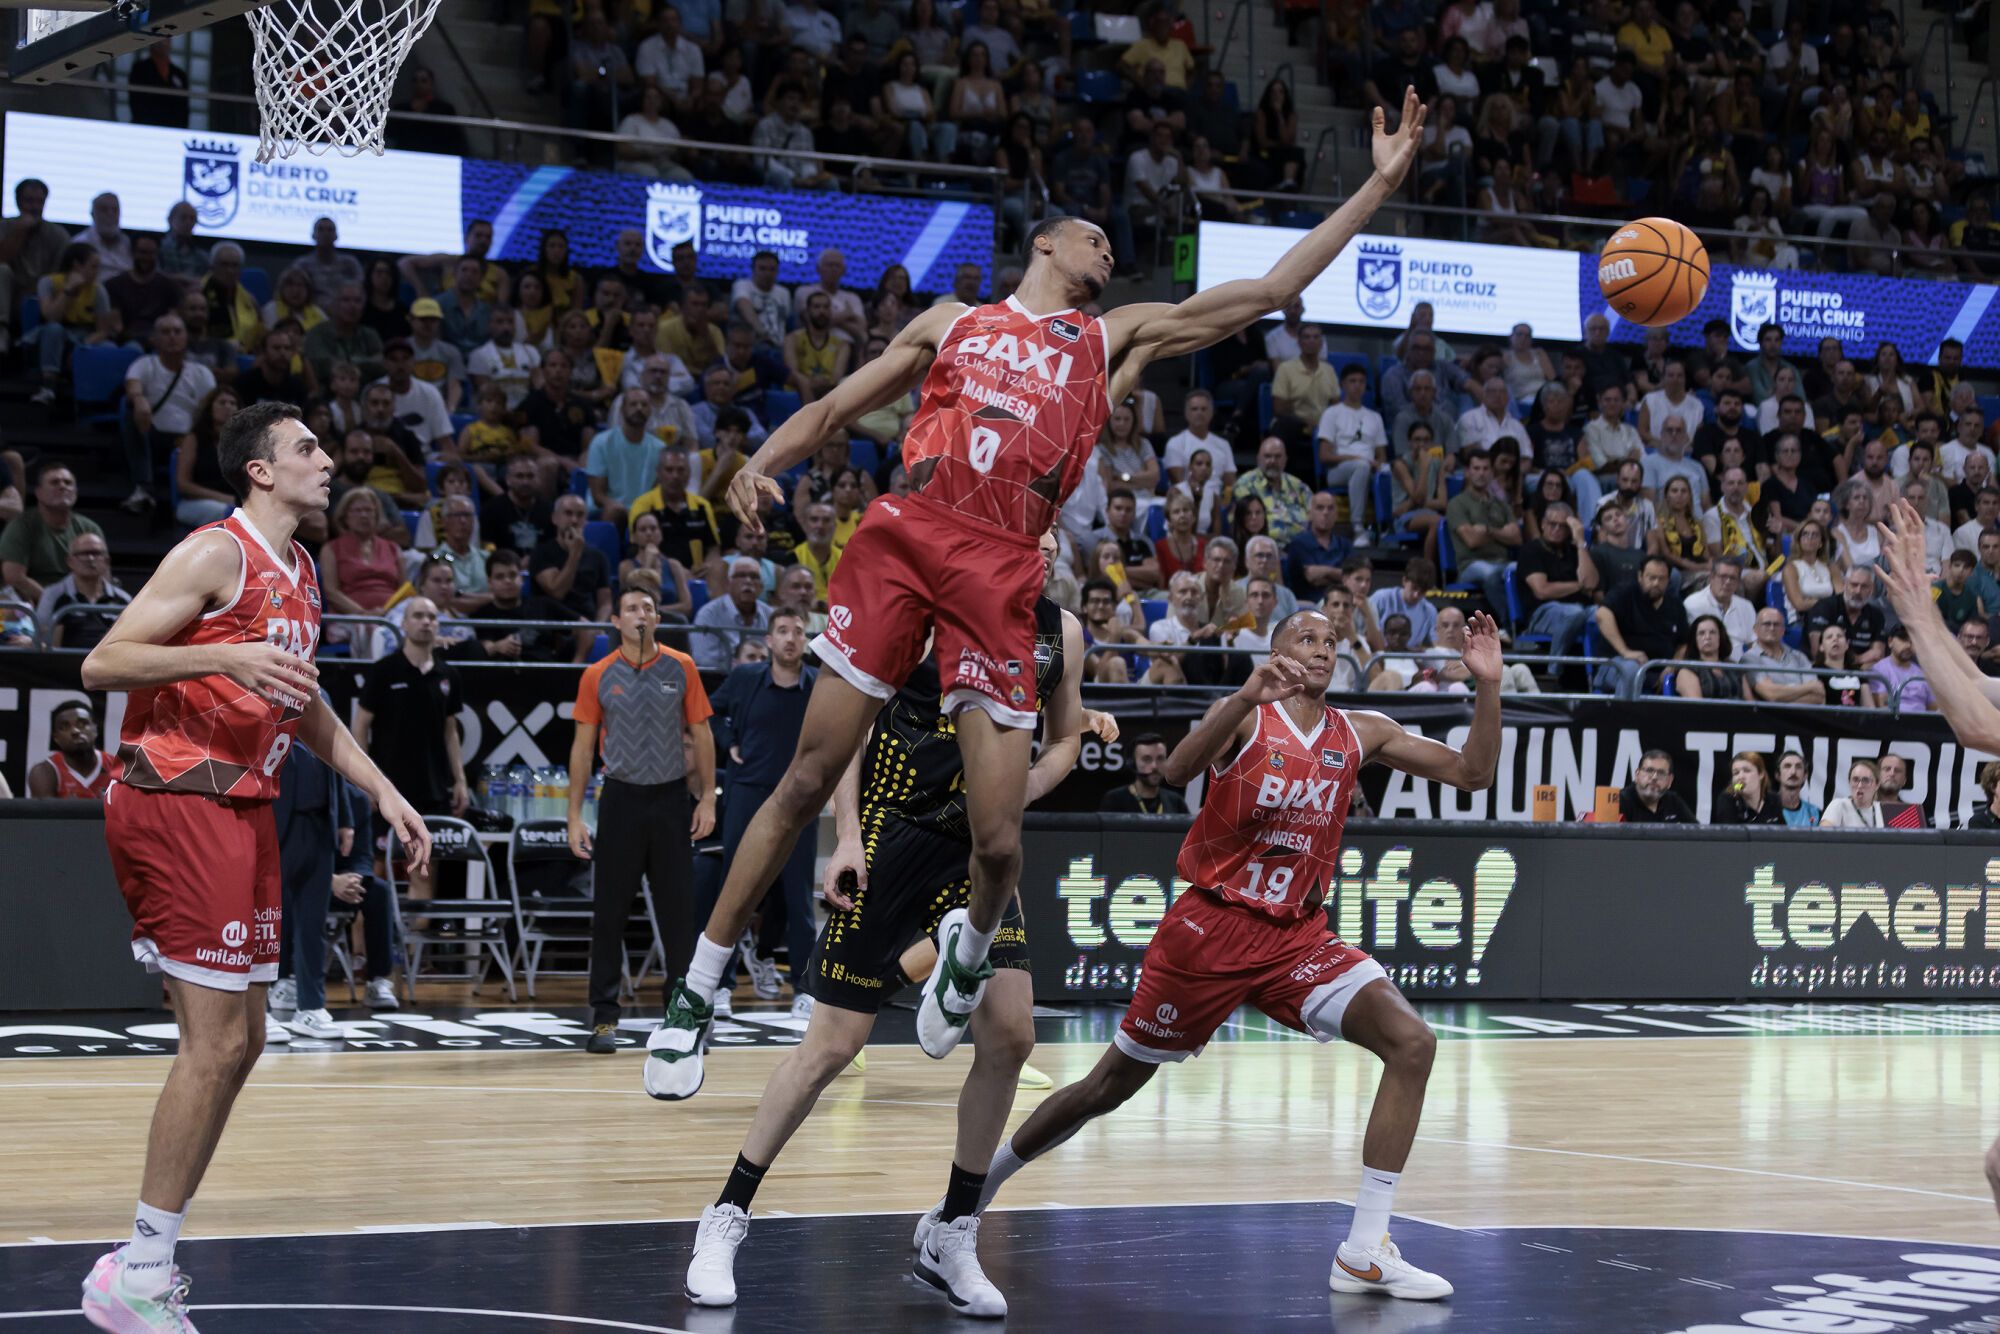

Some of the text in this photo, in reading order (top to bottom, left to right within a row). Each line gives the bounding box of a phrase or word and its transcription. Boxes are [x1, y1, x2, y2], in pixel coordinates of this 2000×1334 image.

[249, 160, 329, 183] PUERTO
[305, 187, 358, 205] CRUZ
[705, 204, 782, 227] PUERTO
[755, 228, 808, 248] CRUZ
[1409, 259, 1473, 277] PUERTO
[1453, 281, 1497, 298] CRUZ
[1781, 289, 1842, 309] PUERTO
[1822, 308, 1865, 328] CRUZ
[957, 332, 1073, 388] BAXI
[954, 355, 1062, 404] CLIMATIZACIÓN
[961, 376, 1037, 426] MANRESA
[968, 426, 1002, 474] 0
[263, 733, 290, 777] 8
[1240, 862, 1294, 904] 19
[1750, 955, 1908, 993] despierta
[1135, 1017, 1187, 1040] unilabor
